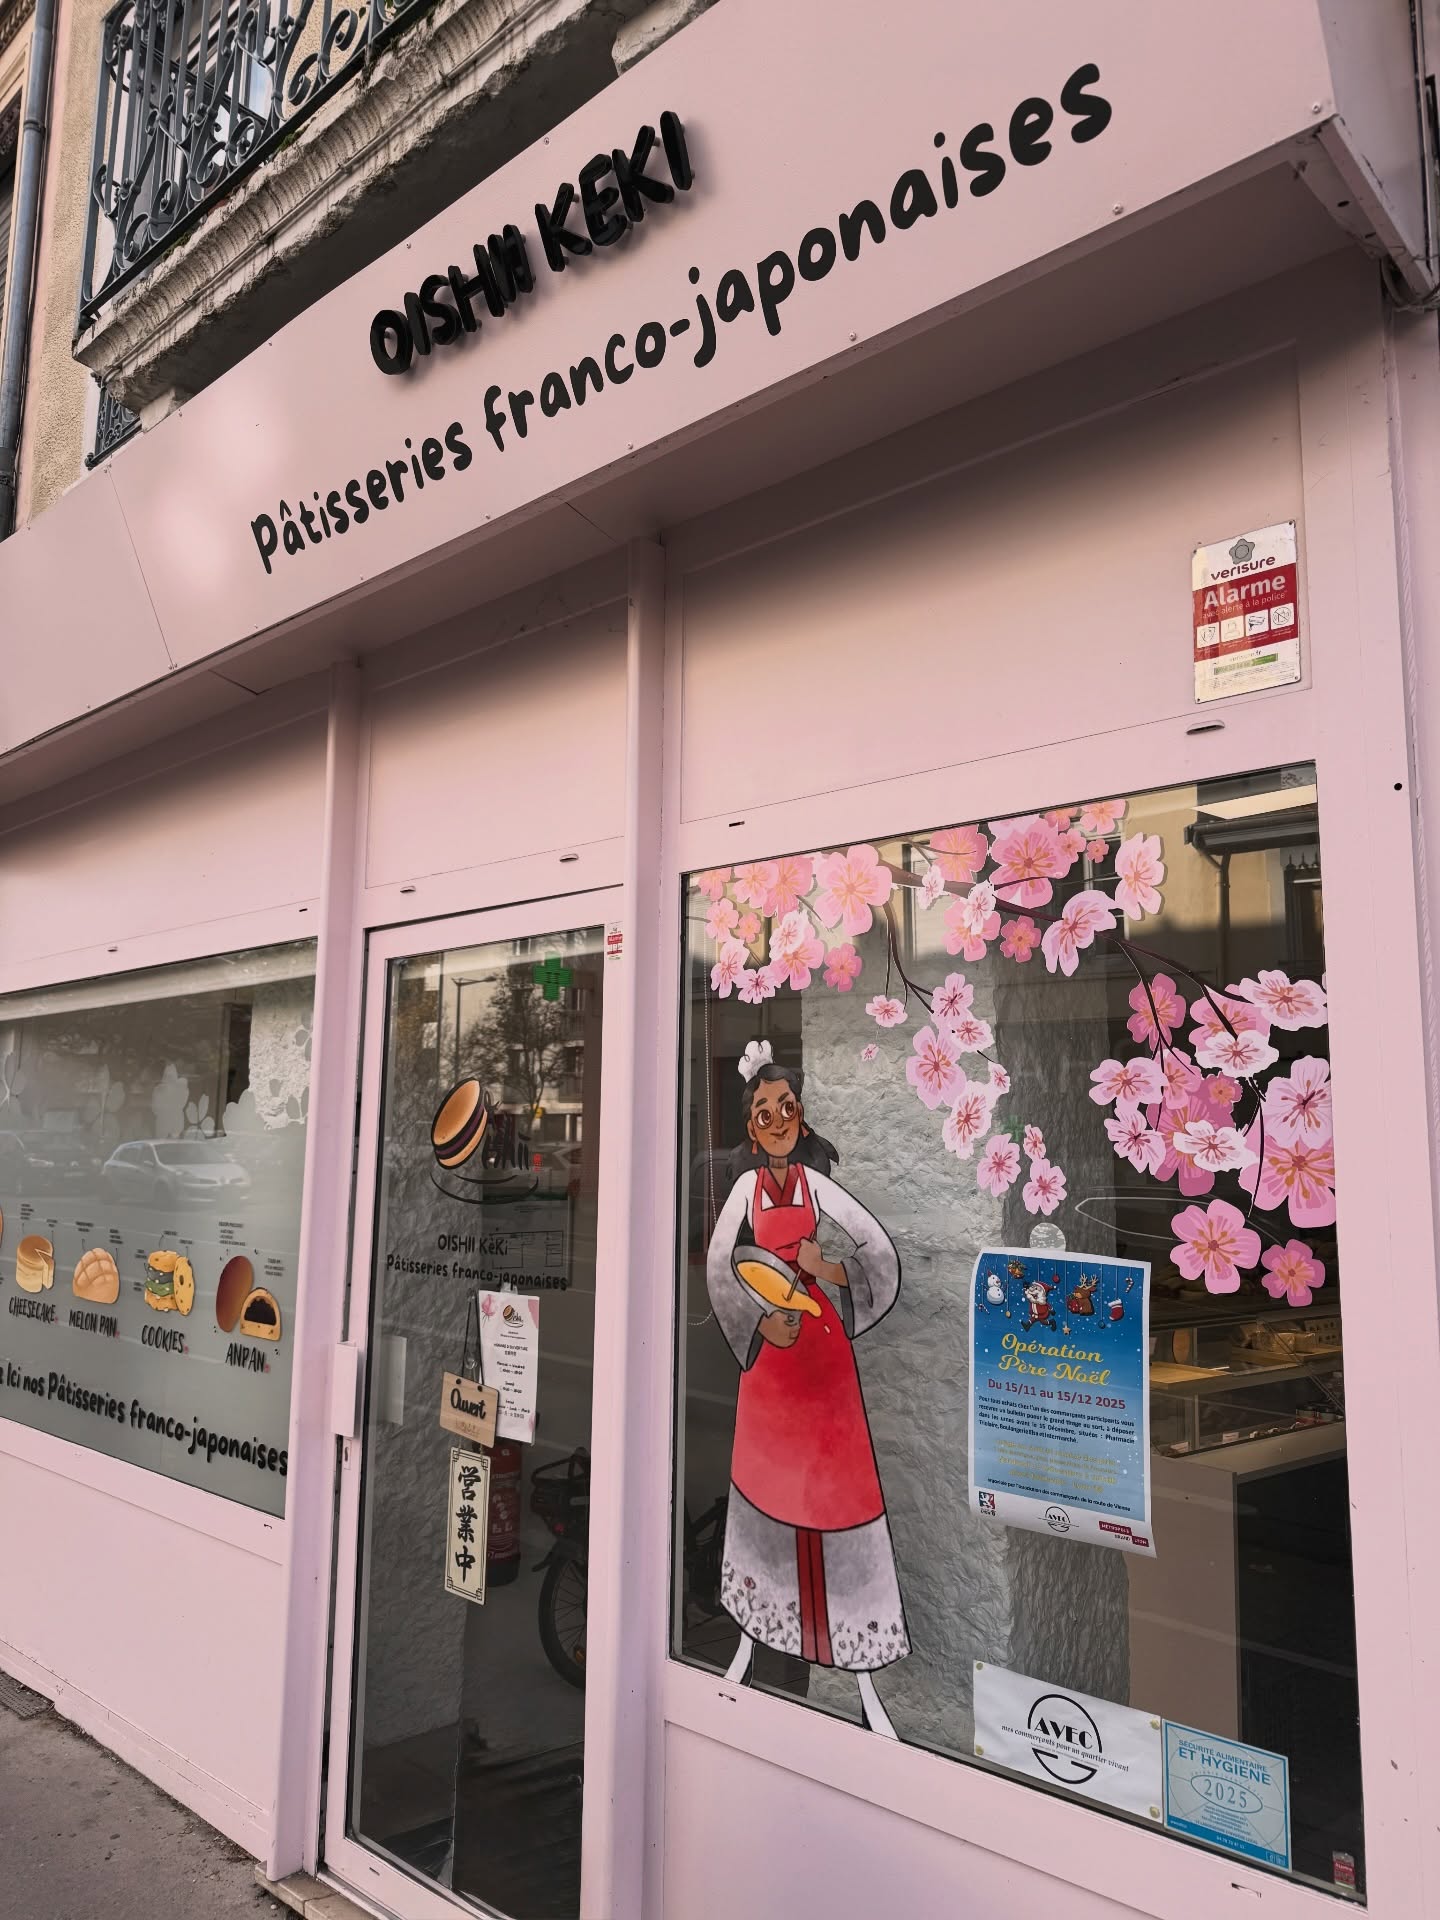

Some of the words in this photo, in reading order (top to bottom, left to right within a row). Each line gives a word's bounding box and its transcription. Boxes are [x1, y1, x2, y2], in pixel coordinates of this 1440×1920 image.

[369, 221, 537, 376] OISHII
[534, 110, 695, 273] KEKI
[249, 422, 473, 575] Pâtisseries
[483, 61, 1114, 455] franco-japonaises
[1210, 556, 1276, 581] verisure
[1203, 575, 1286, 610] Alarme
[437, 1234, 475, 1254] OISHII
[386, 1253, 449, 1278] Pâtisseries
[452, 1262, 568, 1291] franco-japonaises
[8, 1296, 56, 1324] CHEESECAKE
[69, 1309, 98, 1333] MELON
[99, 1315, 118, 1338] PAN
[141, 1325, 185, 1354] COOKIES
[1001, 1333, 1104, 1363] Opération
[225, 1343, 265, 1373] ANPAN
[998, 1354, 1048, 1377] Père
[1052, 1362, 1111, 1386] Noël
[988, 1378, 1002, 1390] Du
[1005, 1381, 1037, 1396] 15/11
[1039, 1389, 1054, 1399] au
[1057, 1390, 1092, 1406] 15/12
[1095, 1396, 1126, 1410] 2025
[6, 1361, 21, 1388] Ici
[23, 1375, 45, 1397] nos
[47, 1371, 125, 1424] Pâtisseries
[129, 1399, 288, 1477] franco-japonaises
[454, 1465, 482, 1584] 営業中
[1034, 1716, 1093, 1750] AVEC
[1056, 1741, 1071, 1752] pour
[1071, 1746, 1080, 1754] un
[1080, 1749, 1107, 1763] quartier
[1107, 1758, 1130, 1772] vivant
[1178, 1746, 1197, 1761] ET
[1215, 1751, 1268, 1773] ALIMENTAIRE
[1203, 1778, 1248, 1810] 2025
